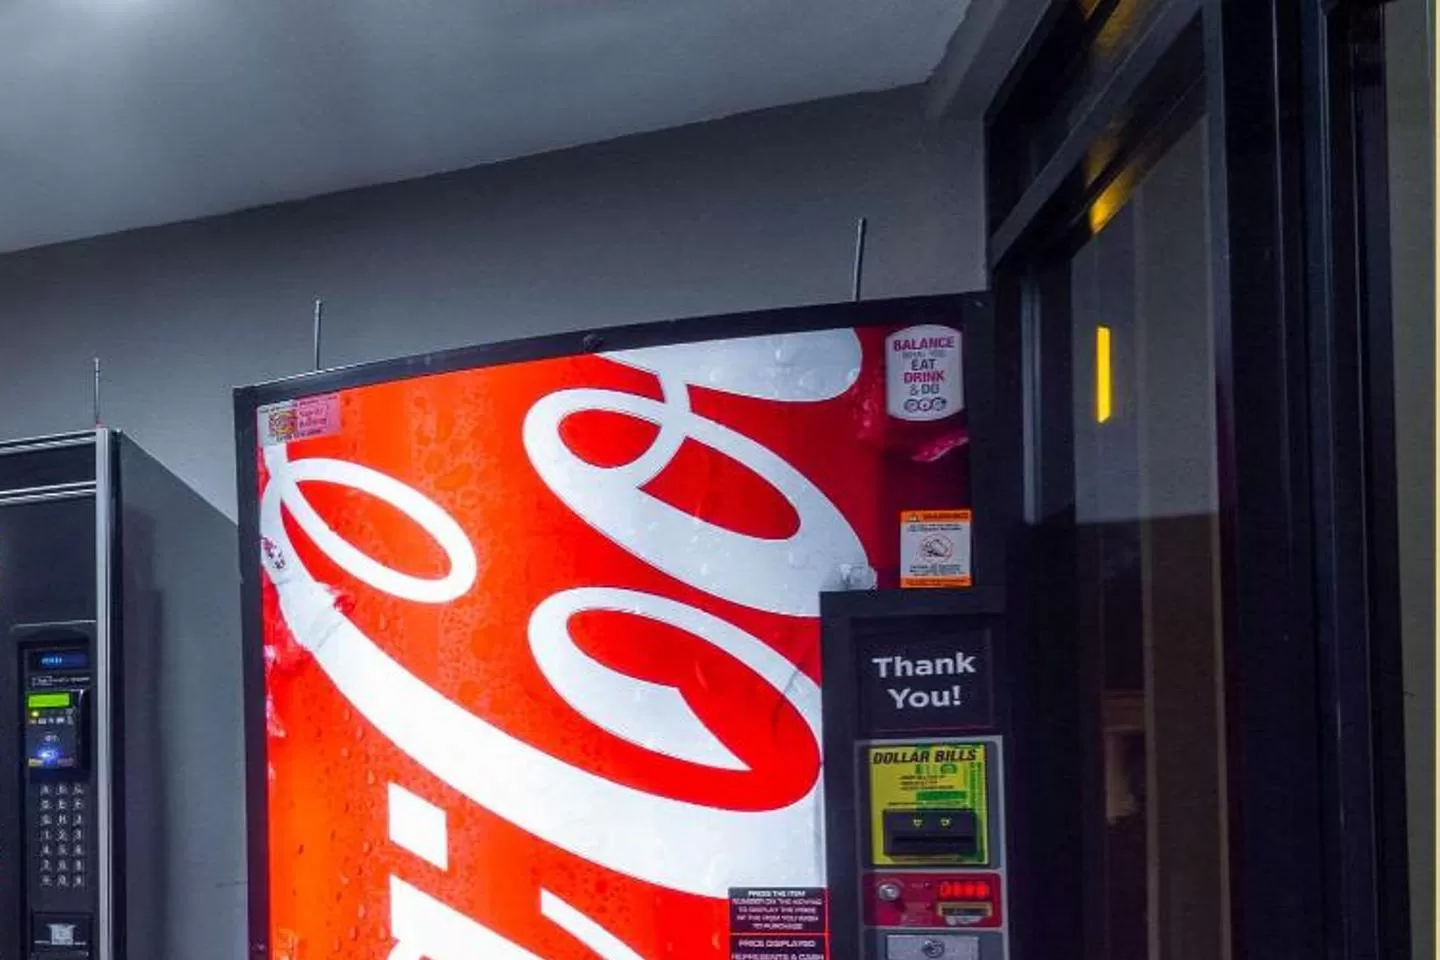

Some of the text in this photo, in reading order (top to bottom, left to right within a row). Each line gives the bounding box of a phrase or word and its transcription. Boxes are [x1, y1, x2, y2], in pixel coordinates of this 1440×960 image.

[893, 335, 955, 351] BALANCE
[911, 359, 936, 371] EAT
[904, 371, 945, 385] DRINK
[921, 383, 940, 395] DO
[872, 652, 976, 678] Thank
[887, 685, 961, 709] You!
[873, 749, 977, 765] DOLLAR BILLS
